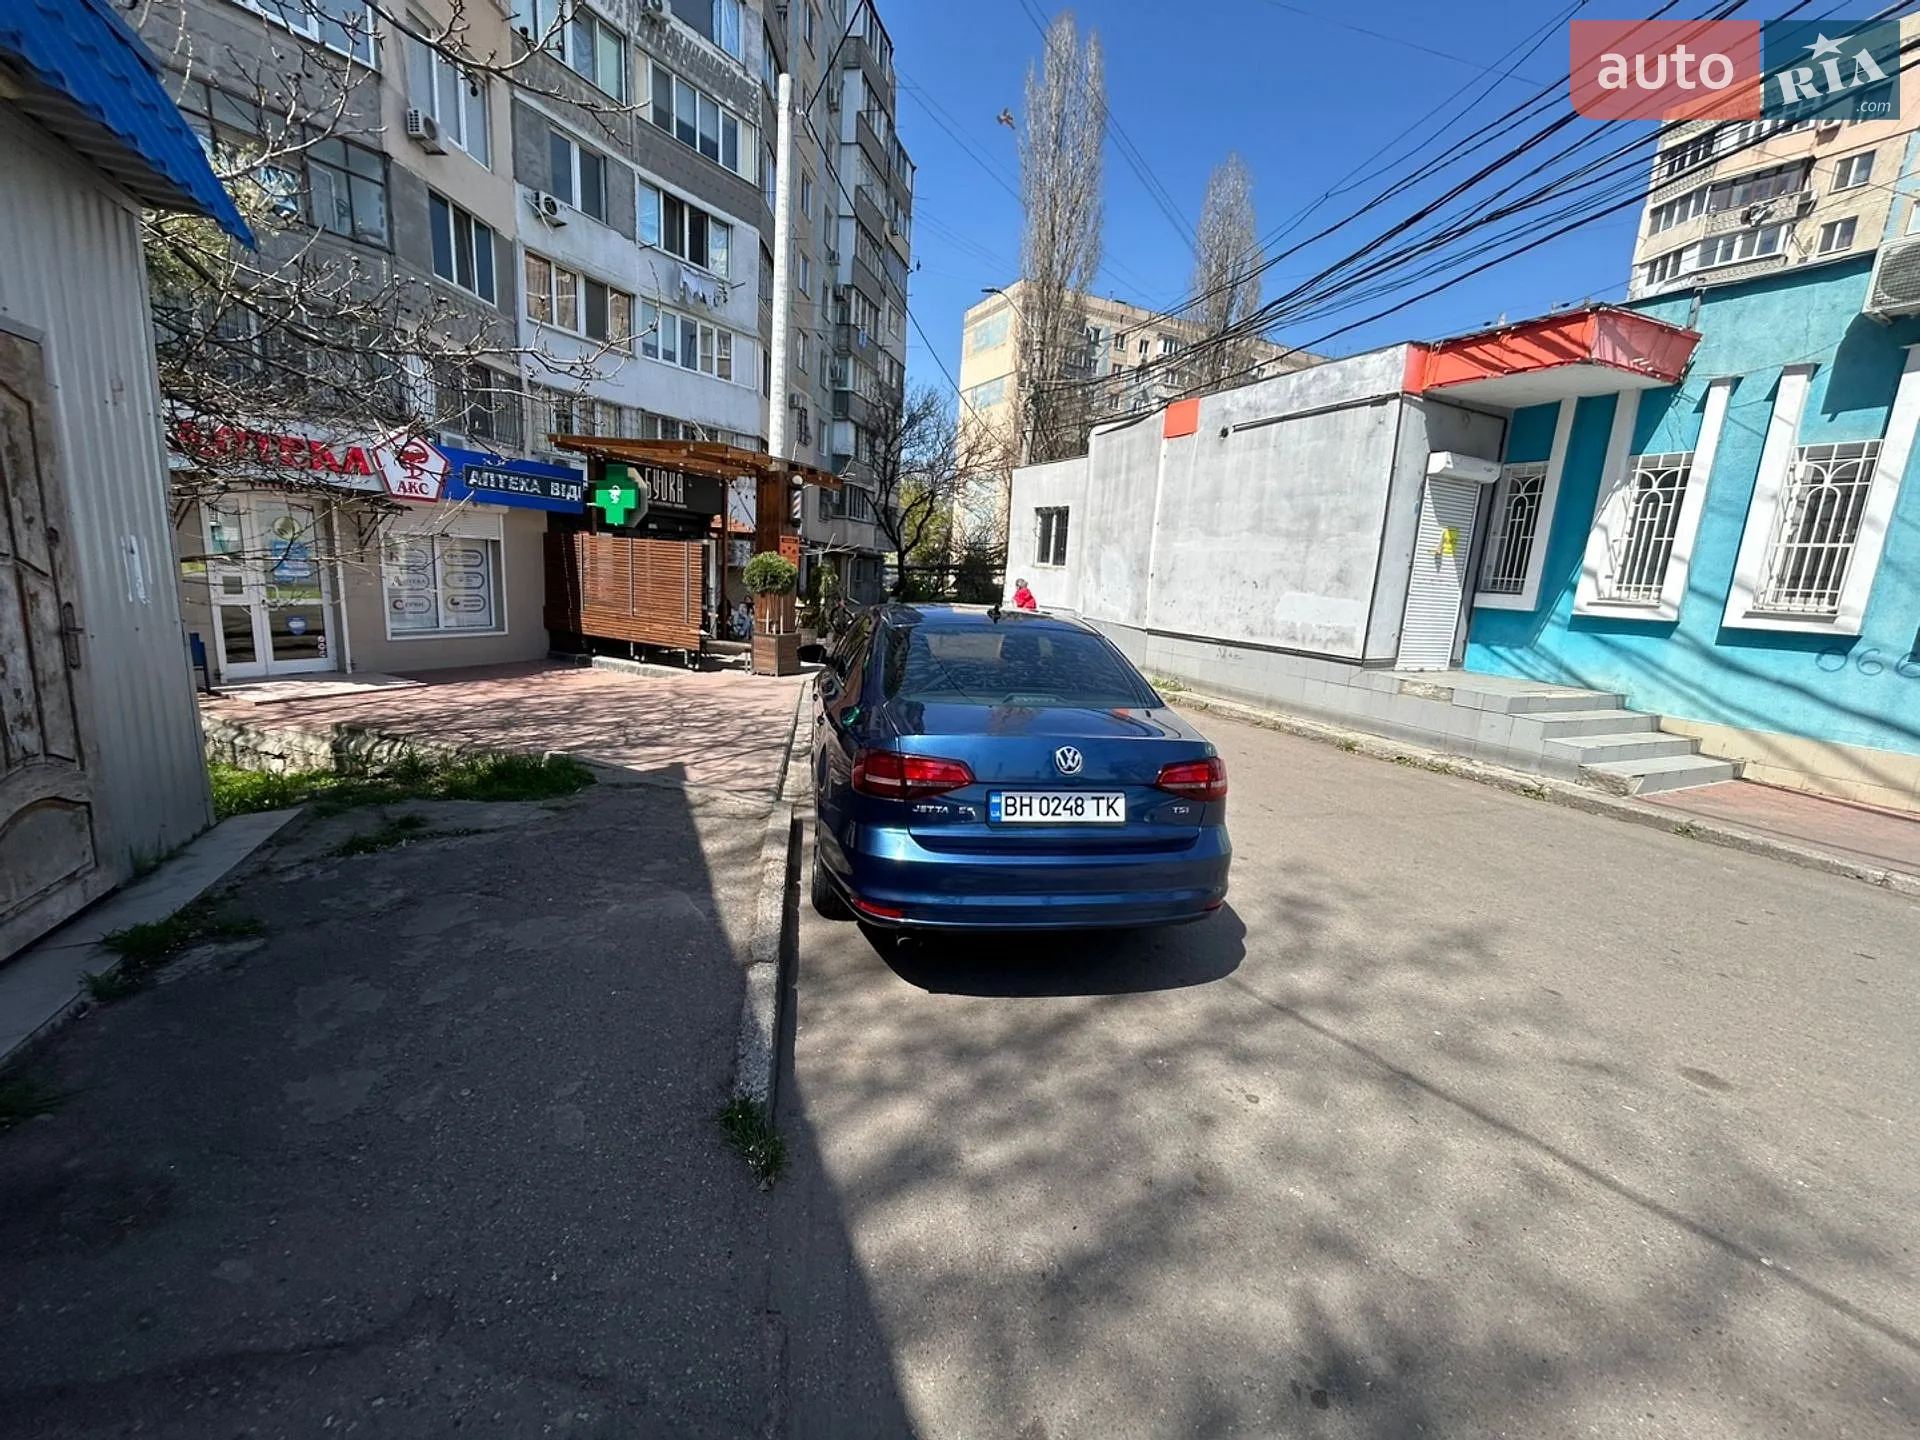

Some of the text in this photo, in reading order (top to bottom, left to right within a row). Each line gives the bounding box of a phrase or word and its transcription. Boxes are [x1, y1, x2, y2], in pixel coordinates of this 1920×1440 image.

[397, 480, 430, 495] АКС
[468, 470, 541, 494] АПТЕКА
[912, 804, 949, 814] JETTA
[1005, 796, 1120, 816] BH 0248 TK
